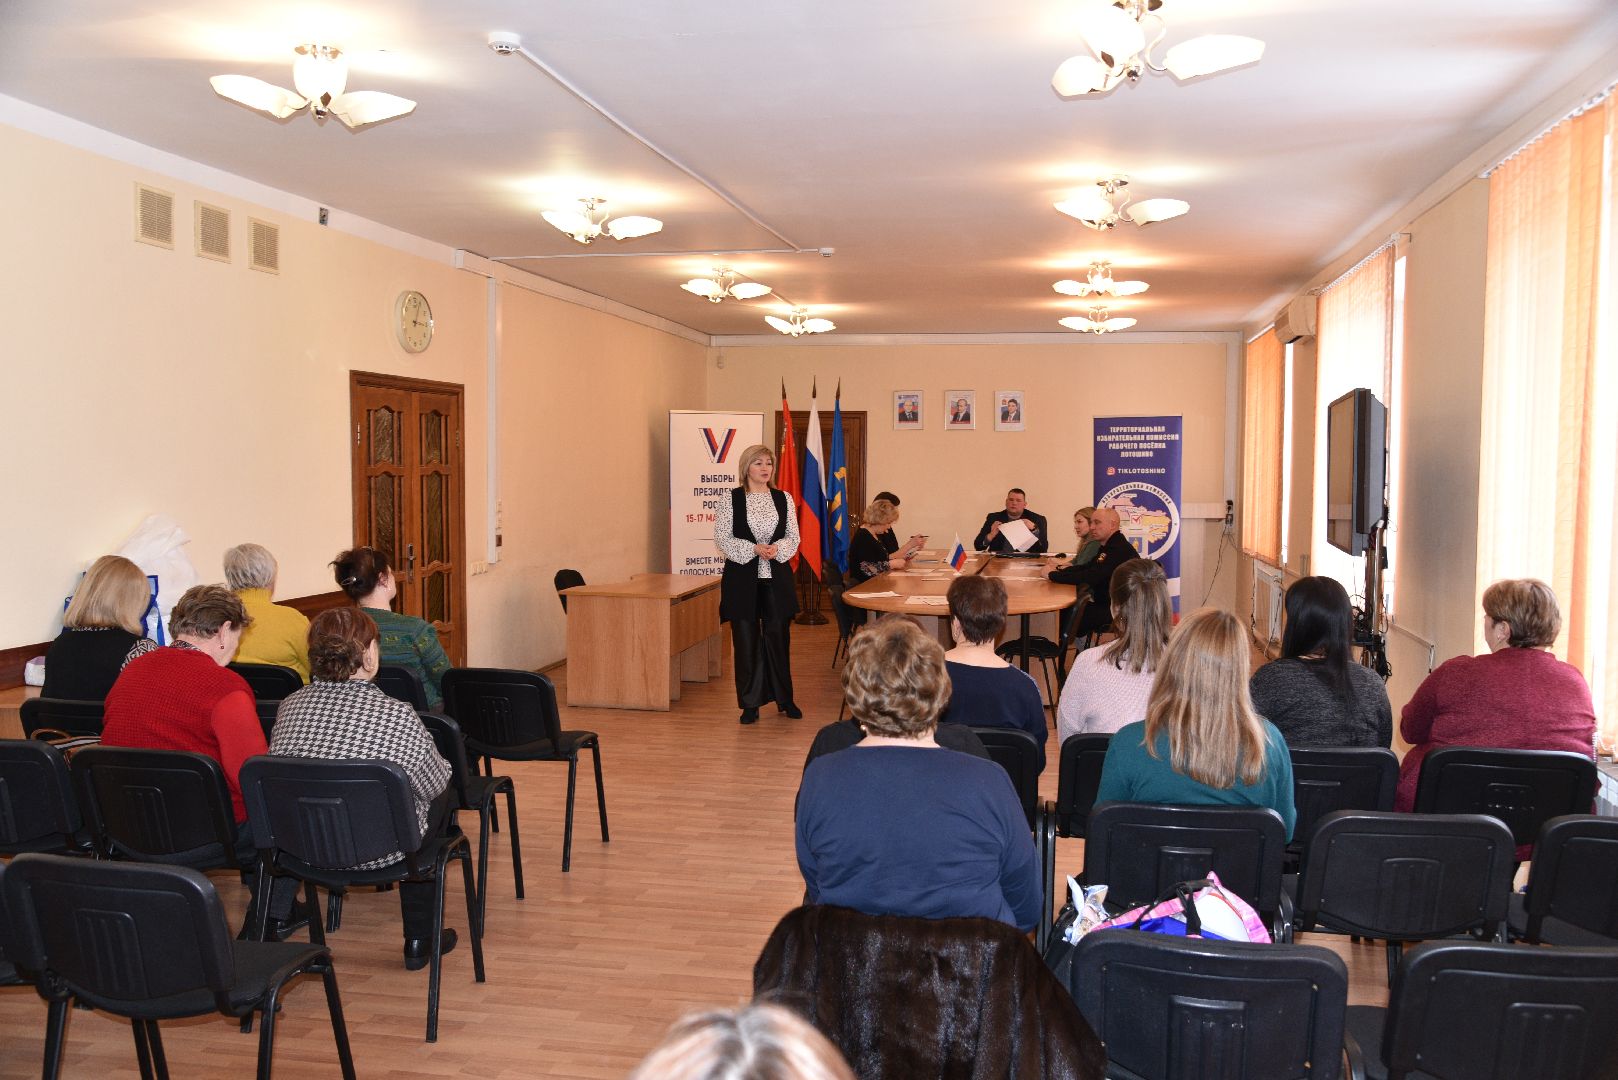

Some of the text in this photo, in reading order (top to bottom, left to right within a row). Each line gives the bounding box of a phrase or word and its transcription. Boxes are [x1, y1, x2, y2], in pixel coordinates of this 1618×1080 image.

[700, 474, 735, 483] ВЫБОРЫ
[702, 500, 718, 510] РОС
[685, 514, 704, 523] 15-17
[685, 556, 712, 566] ВМЕСТЕ
[679, 567, 715, 576] ГОЛОСУЕМ
